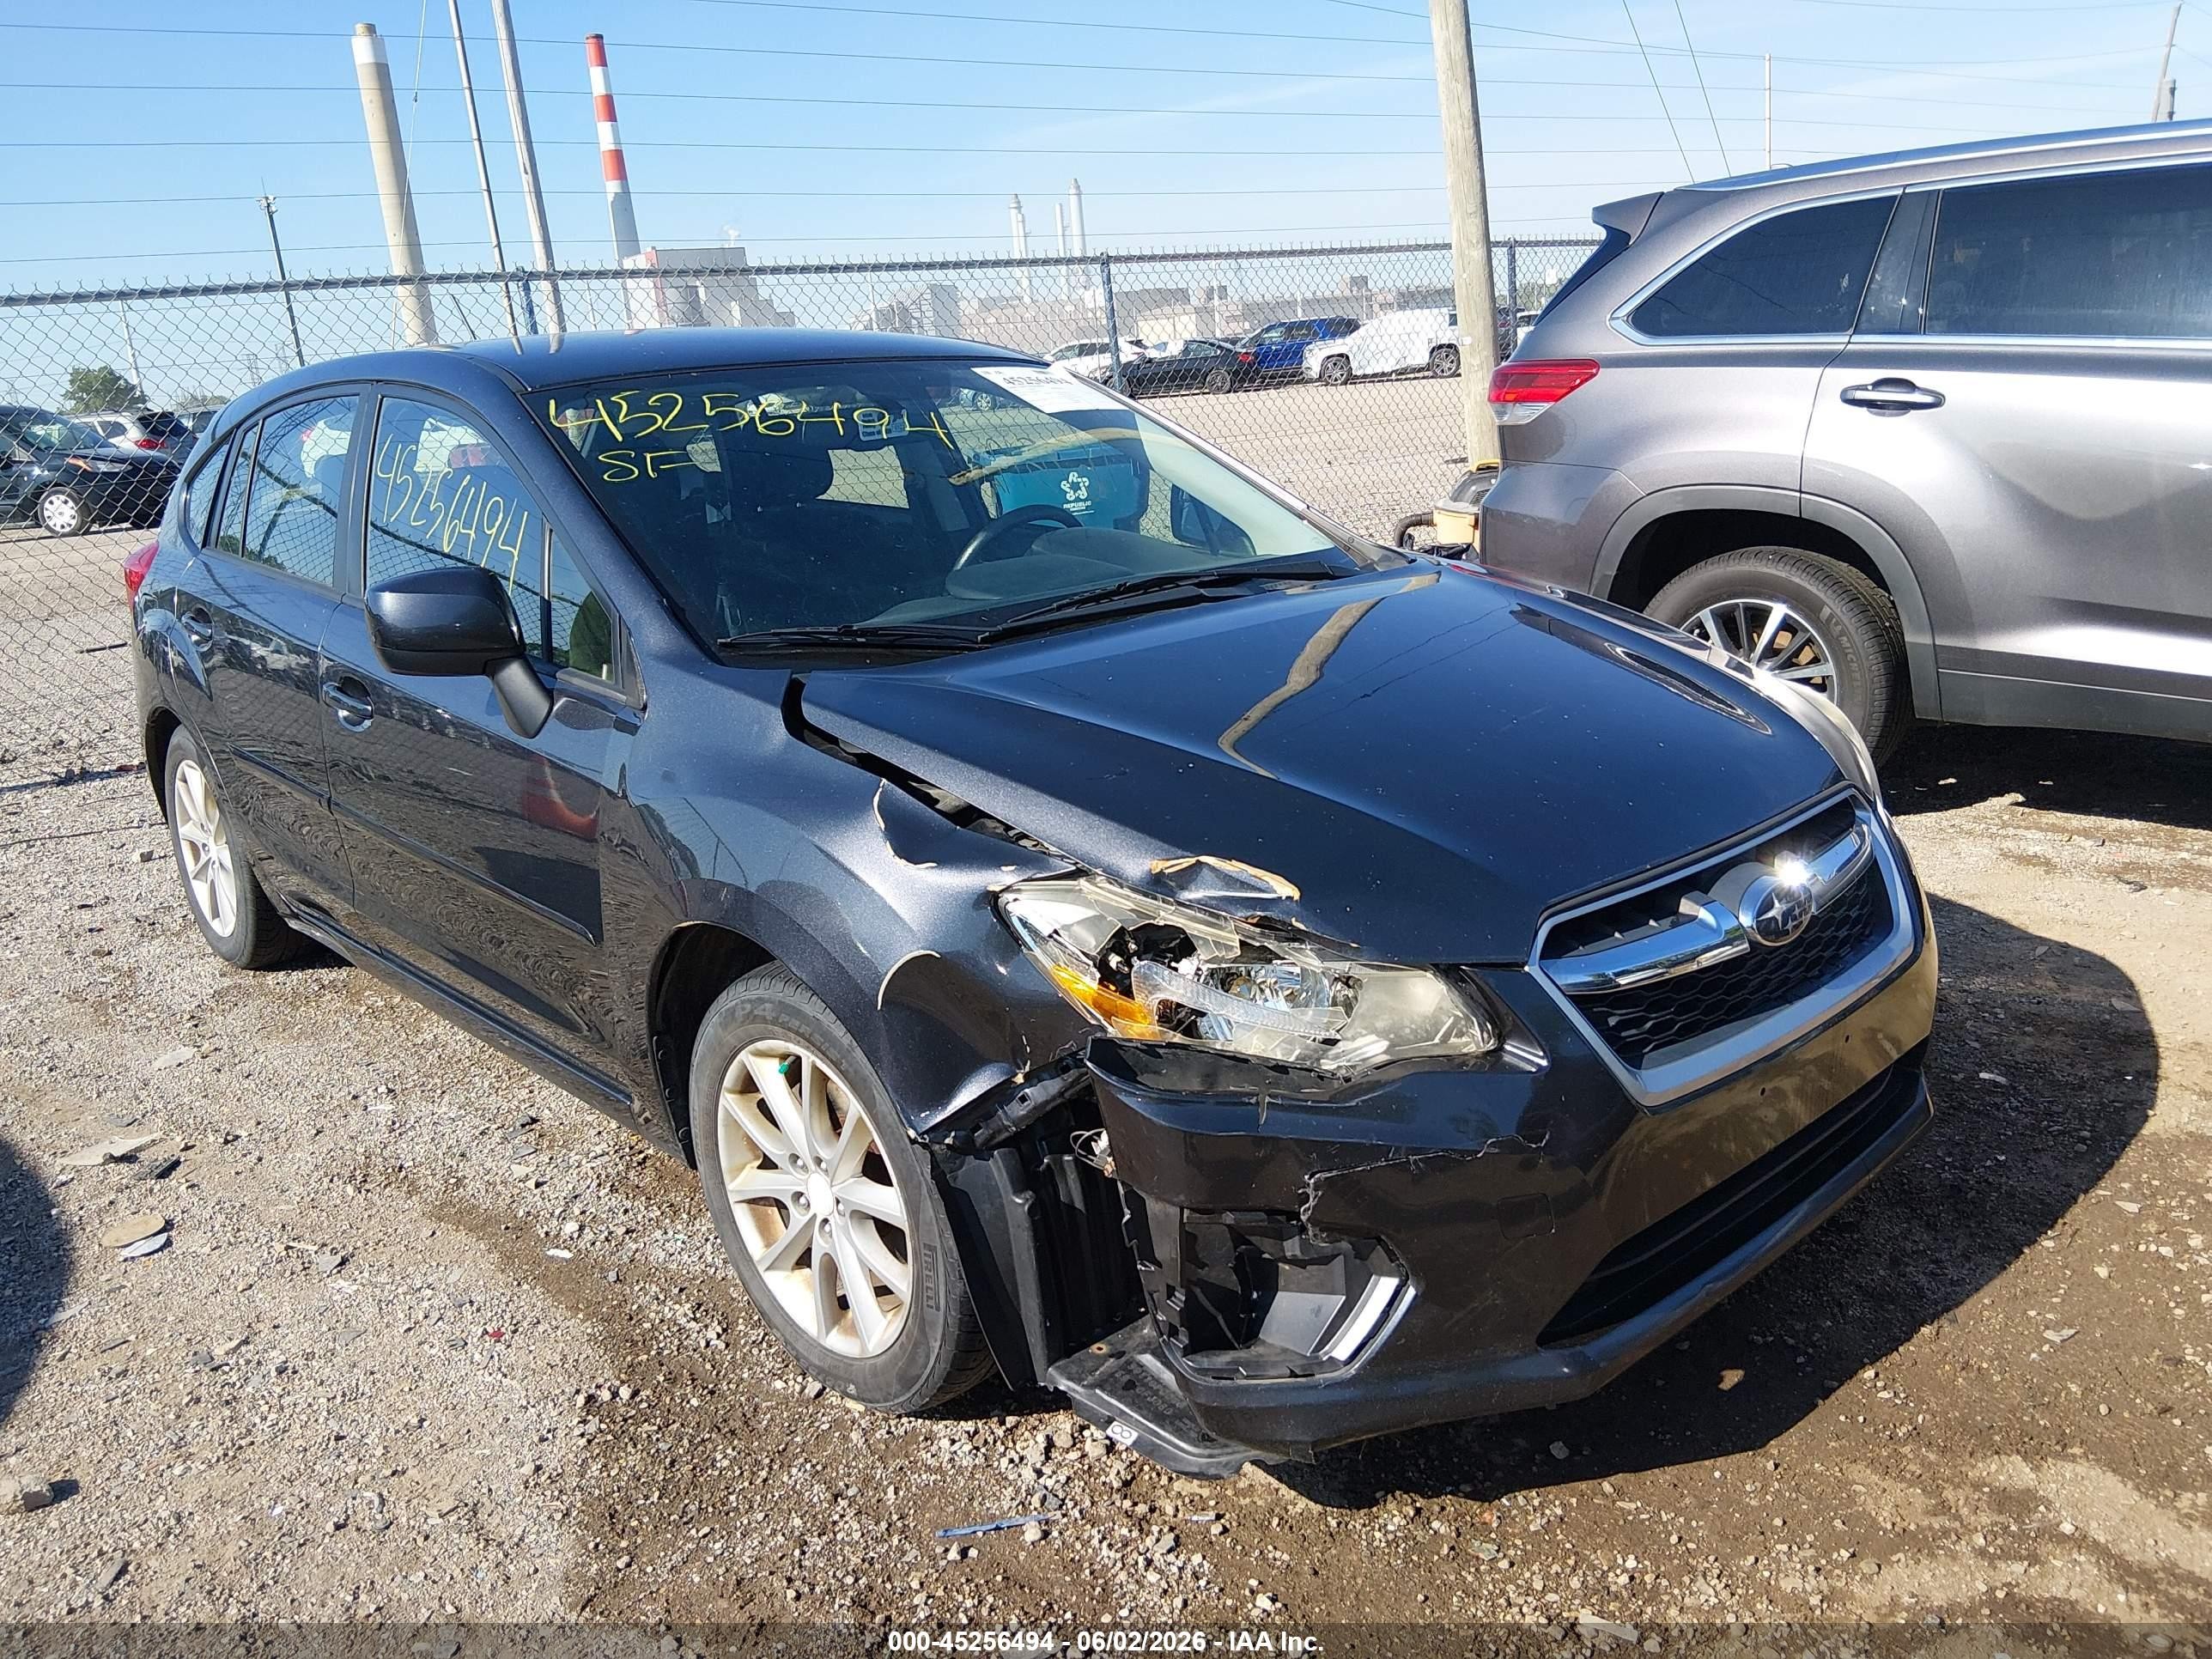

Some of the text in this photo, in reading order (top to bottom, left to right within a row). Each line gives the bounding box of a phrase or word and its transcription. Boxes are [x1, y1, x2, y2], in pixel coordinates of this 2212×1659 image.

[548, 390, 954, 450] 45256494
[599, 450, 698, 481] SF
[376, 432, 529, 596] 45256494
[922, 1242, 941, 1312] PIRELLI
